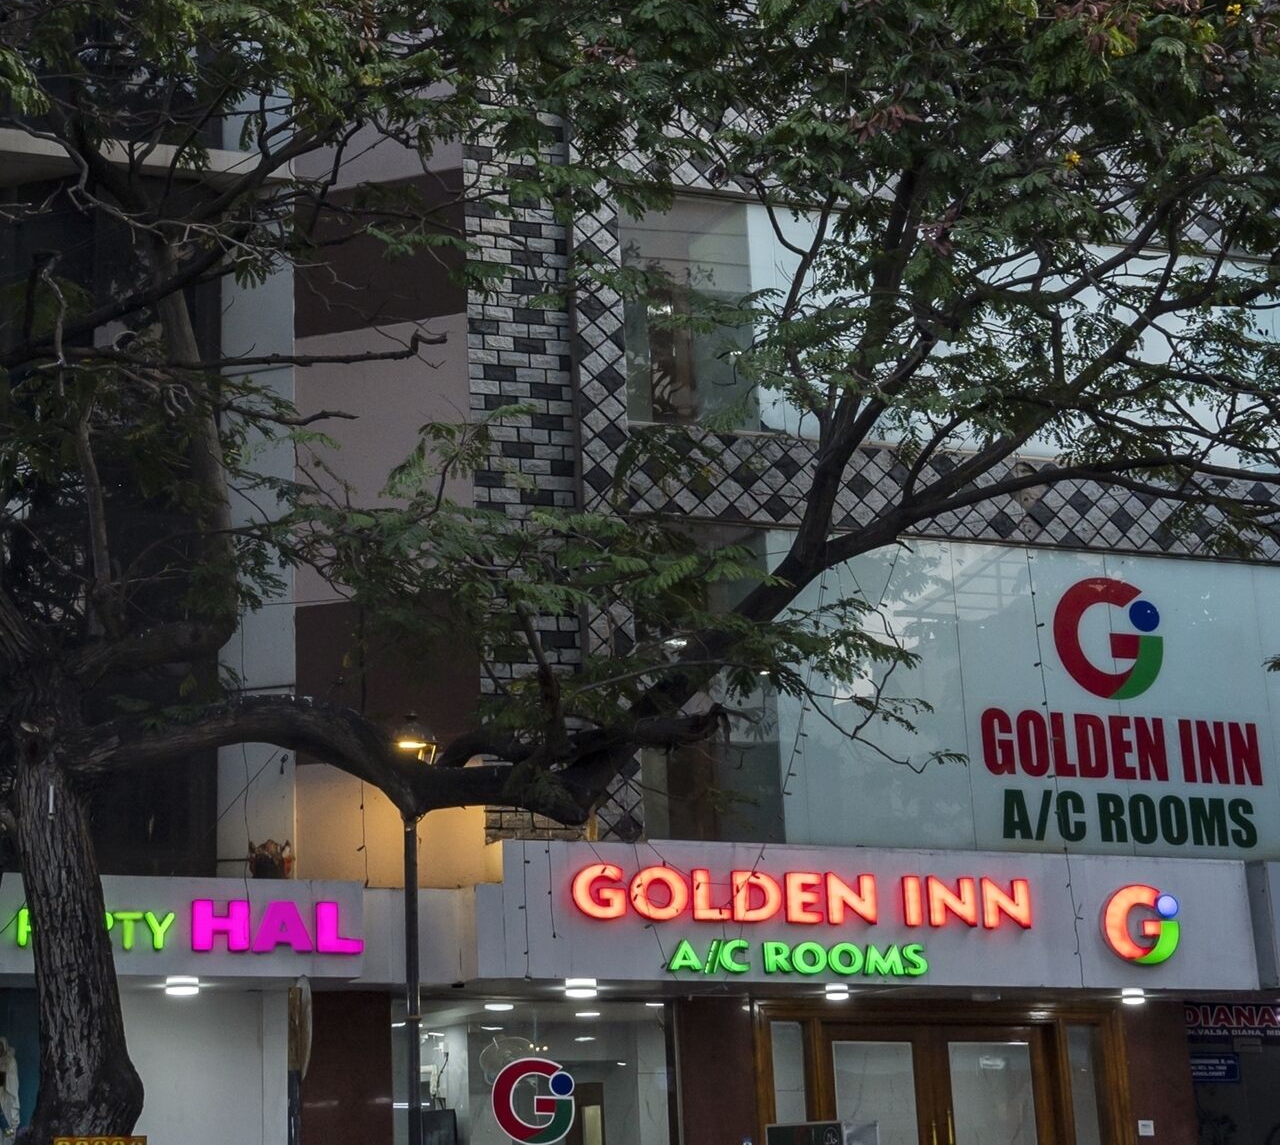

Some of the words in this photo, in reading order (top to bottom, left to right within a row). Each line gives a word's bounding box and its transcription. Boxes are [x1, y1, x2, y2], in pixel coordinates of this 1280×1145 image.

[981, 708, 1169, 782] GOLDEN
[1178, 719, 1263, 786] INN
[1003, 789, 1086, 842] A/C
[1097, 792, 1258, 848] ROOMS
[572, 863, 877, 926] GOLDEN
[901, 875, 1032, 929] INN
[191, 899, 364, 954] HAL
[668, 939, 751, 974] A/C
[762, 941, 928, 976] ROOMS
[1184, 1005, 1280, 1028] DIANA
